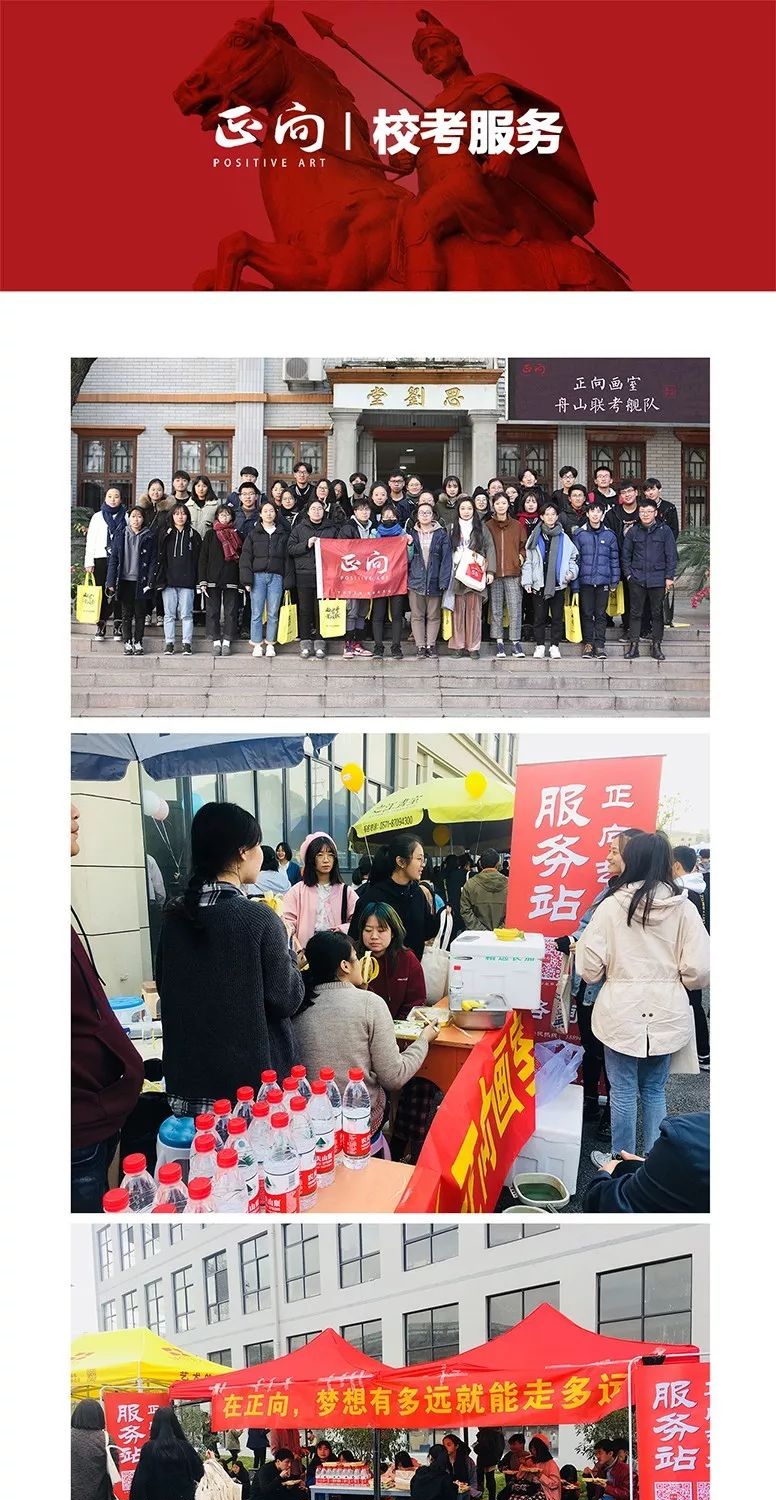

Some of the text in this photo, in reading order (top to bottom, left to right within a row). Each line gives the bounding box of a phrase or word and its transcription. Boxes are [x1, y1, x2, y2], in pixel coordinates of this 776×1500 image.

[573, 376, 642, 391] 正向画室
[555, 397, 660, 413] 舟山联考舰队
[340, 550, 389, 574] 正向
[528, 783, 591, 922] 服务站
[652, 1380, 700, 1471] 服务站
